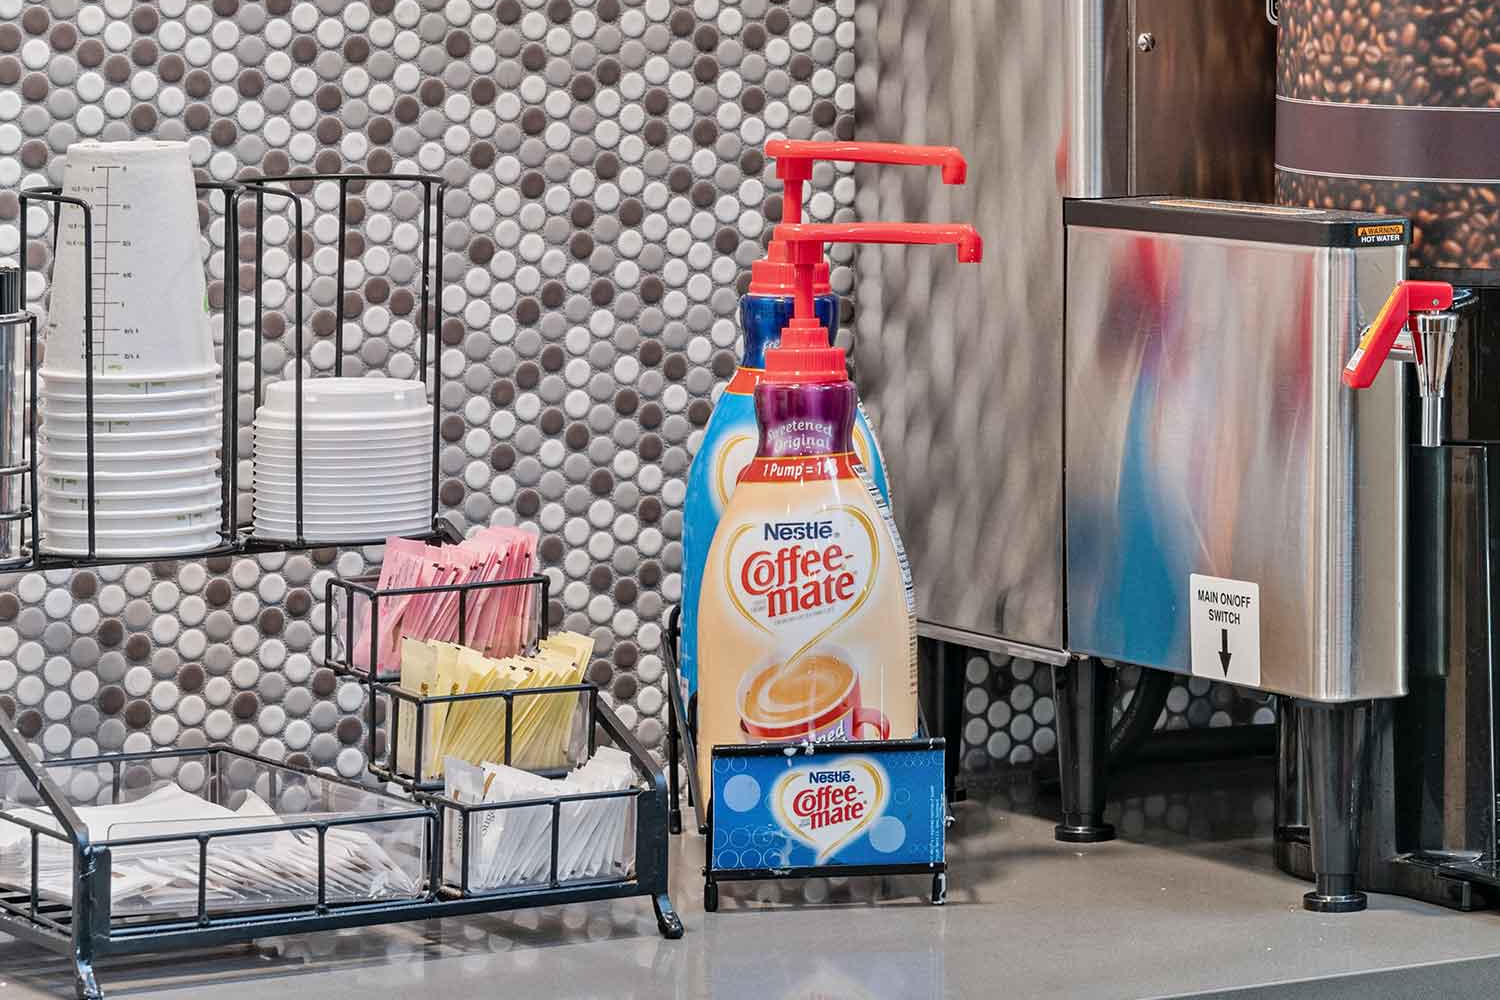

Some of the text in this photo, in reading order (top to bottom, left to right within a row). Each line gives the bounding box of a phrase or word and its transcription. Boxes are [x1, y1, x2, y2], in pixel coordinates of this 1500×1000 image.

[1367, 226, 1400, 235] WARNING
[1376, 234, 1400, 242] WATER
[770, 462, 803, 480] Pump
[766, 572, 855, 618] mate
[1197, 588, 1251, 608] MAIN ON/OFF
[1208, 608, 1241, 625] SWITCH
[810, 801, 864, 830] mate
